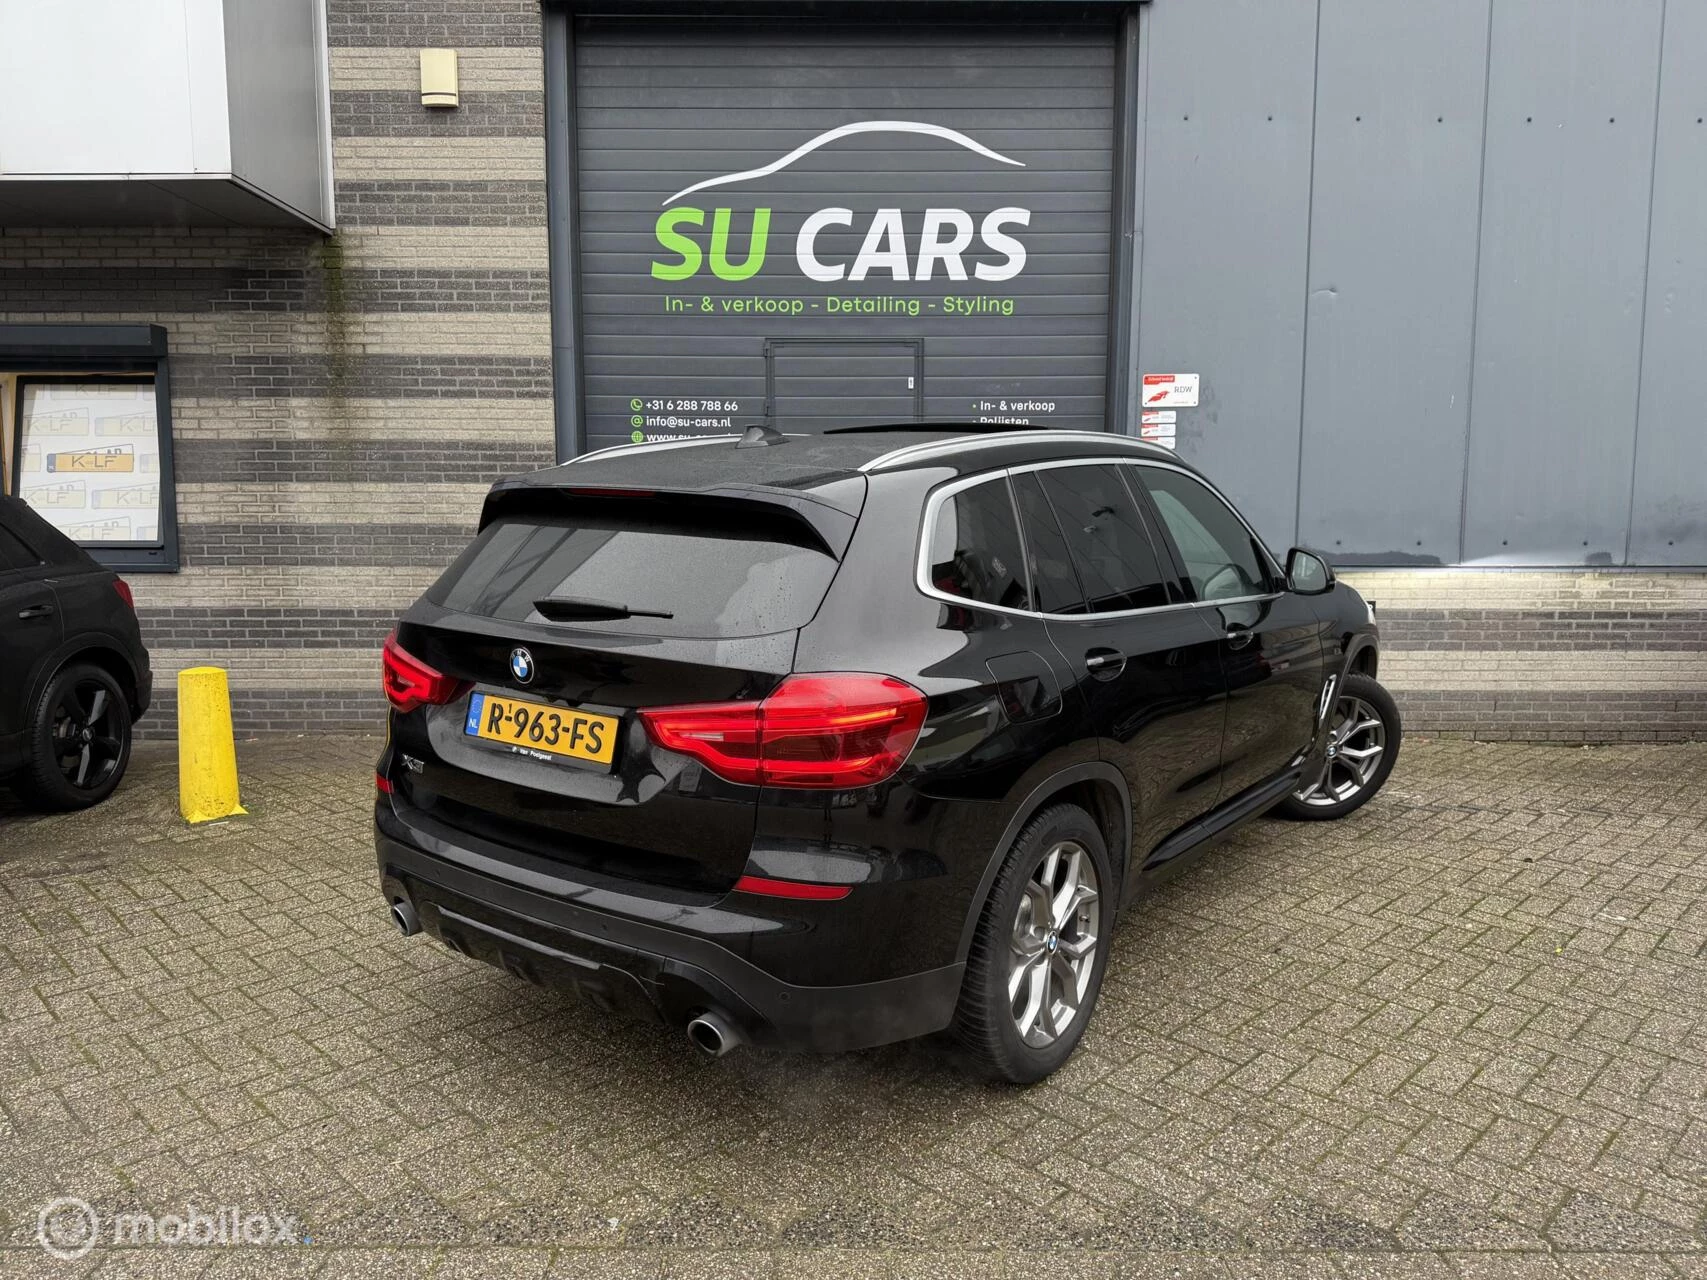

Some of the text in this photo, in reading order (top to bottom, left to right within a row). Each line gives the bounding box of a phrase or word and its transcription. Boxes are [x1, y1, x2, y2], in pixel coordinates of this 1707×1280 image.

[651, 207, 1032, 282] SU CARS
[665, 296, 693, 312] In-
[701, 297, 714, 312] &
[723, 297, 804, 317] verkoop
[826, 296, 920, 317] Detailing
[943, 296, 1015, 317] Styling
[646, 400, 739, 412] +31 6 288 788 66
[980, 400, 1056, 413] In- & verkoop
[646, 416, 732, 428] info@su-cars.nl
[469, 702, 605, 754] NL R-963-FS
